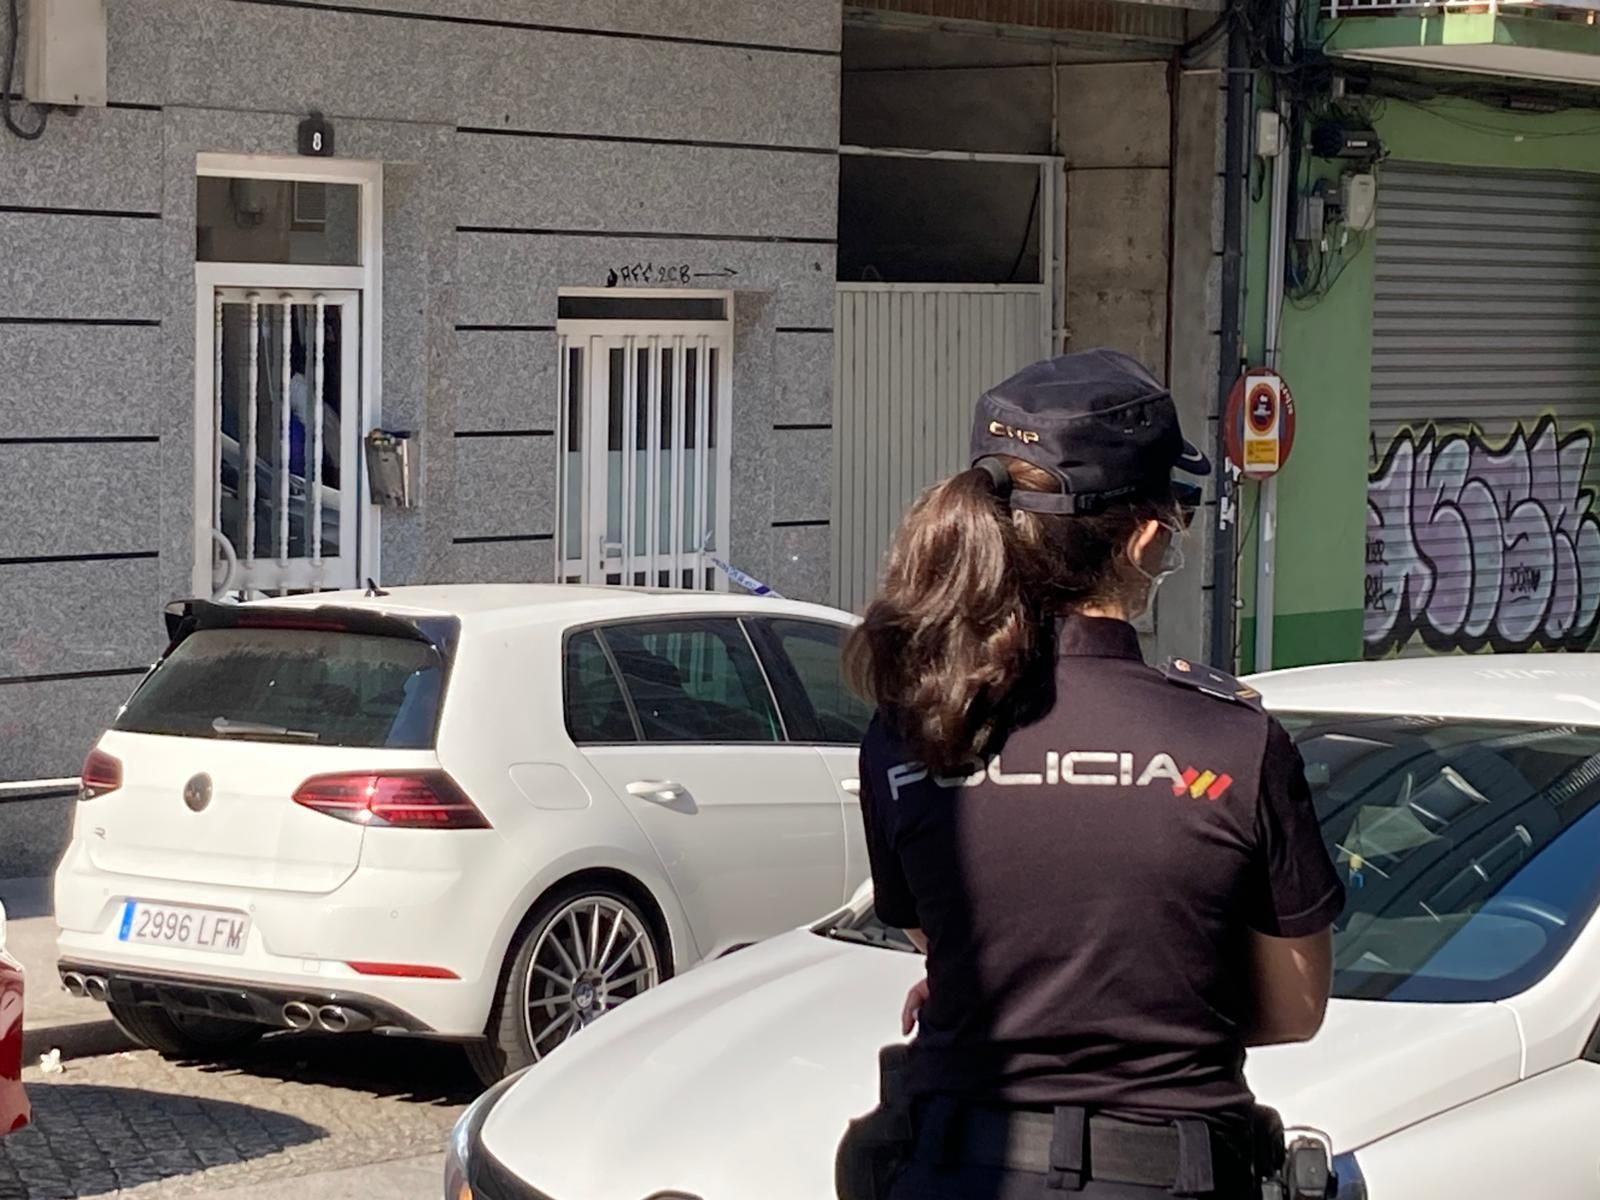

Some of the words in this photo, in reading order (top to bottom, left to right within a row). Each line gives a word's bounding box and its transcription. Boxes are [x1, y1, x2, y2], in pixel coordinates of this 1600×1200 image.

[312, 131, 322, 152] 8
[136, 909, 193, 942] 2996
[197, 915, 245, 950] LFM
